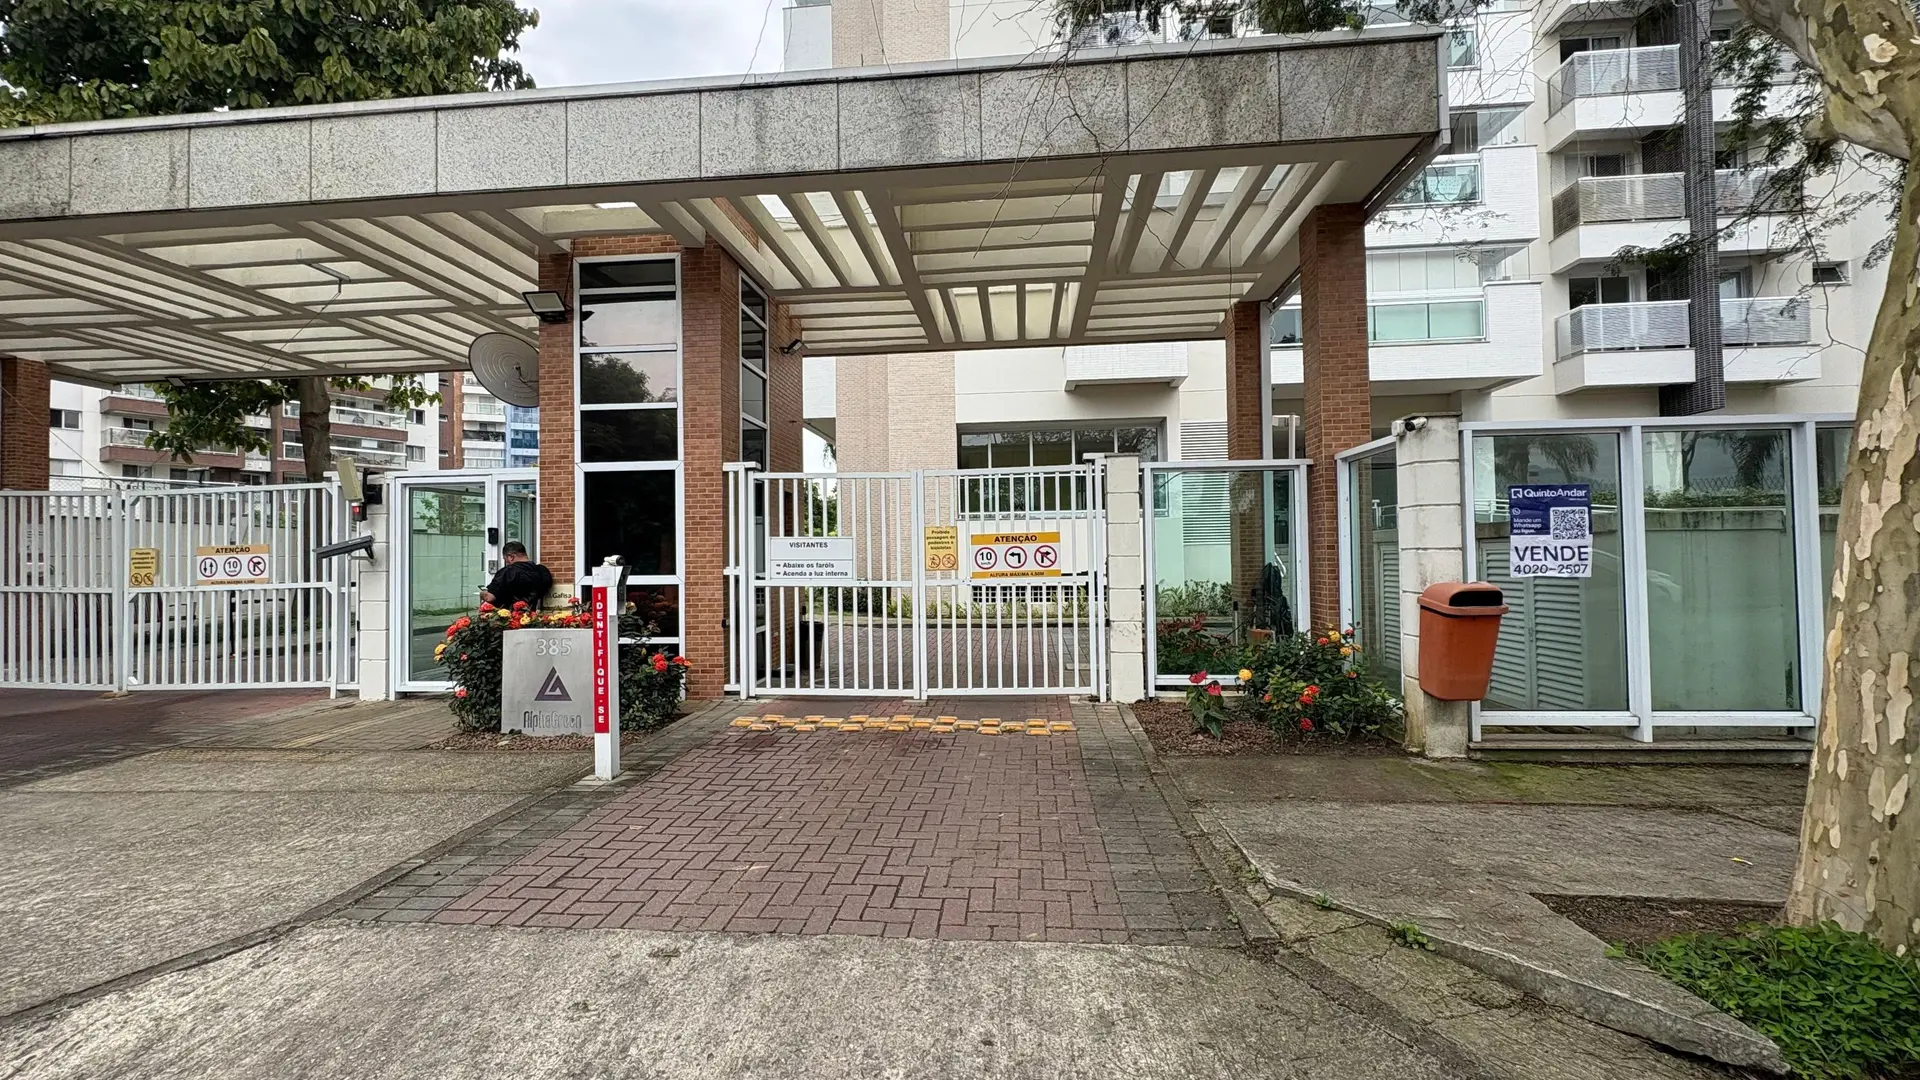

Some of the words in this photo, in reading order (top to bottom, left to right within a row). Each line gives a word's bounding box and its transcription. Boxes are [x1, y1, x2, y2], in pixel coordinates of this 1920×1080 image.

[1524, 488, 1587, 497] QuintoAndar
[994, 534, 1037, 543] ATENÇÃO
[215, 546, 250, 554] ATENÇÃO
[1514, 546, 1589, 562] VENDE
[980, 552, 992, 561] 10
[227, 560, 238, 569] 10
[1514, 563, 1588, 574] 4020-2507
[536, 637, 572, 656] 385
[523, 710, 582, 732] AlphaGreen
